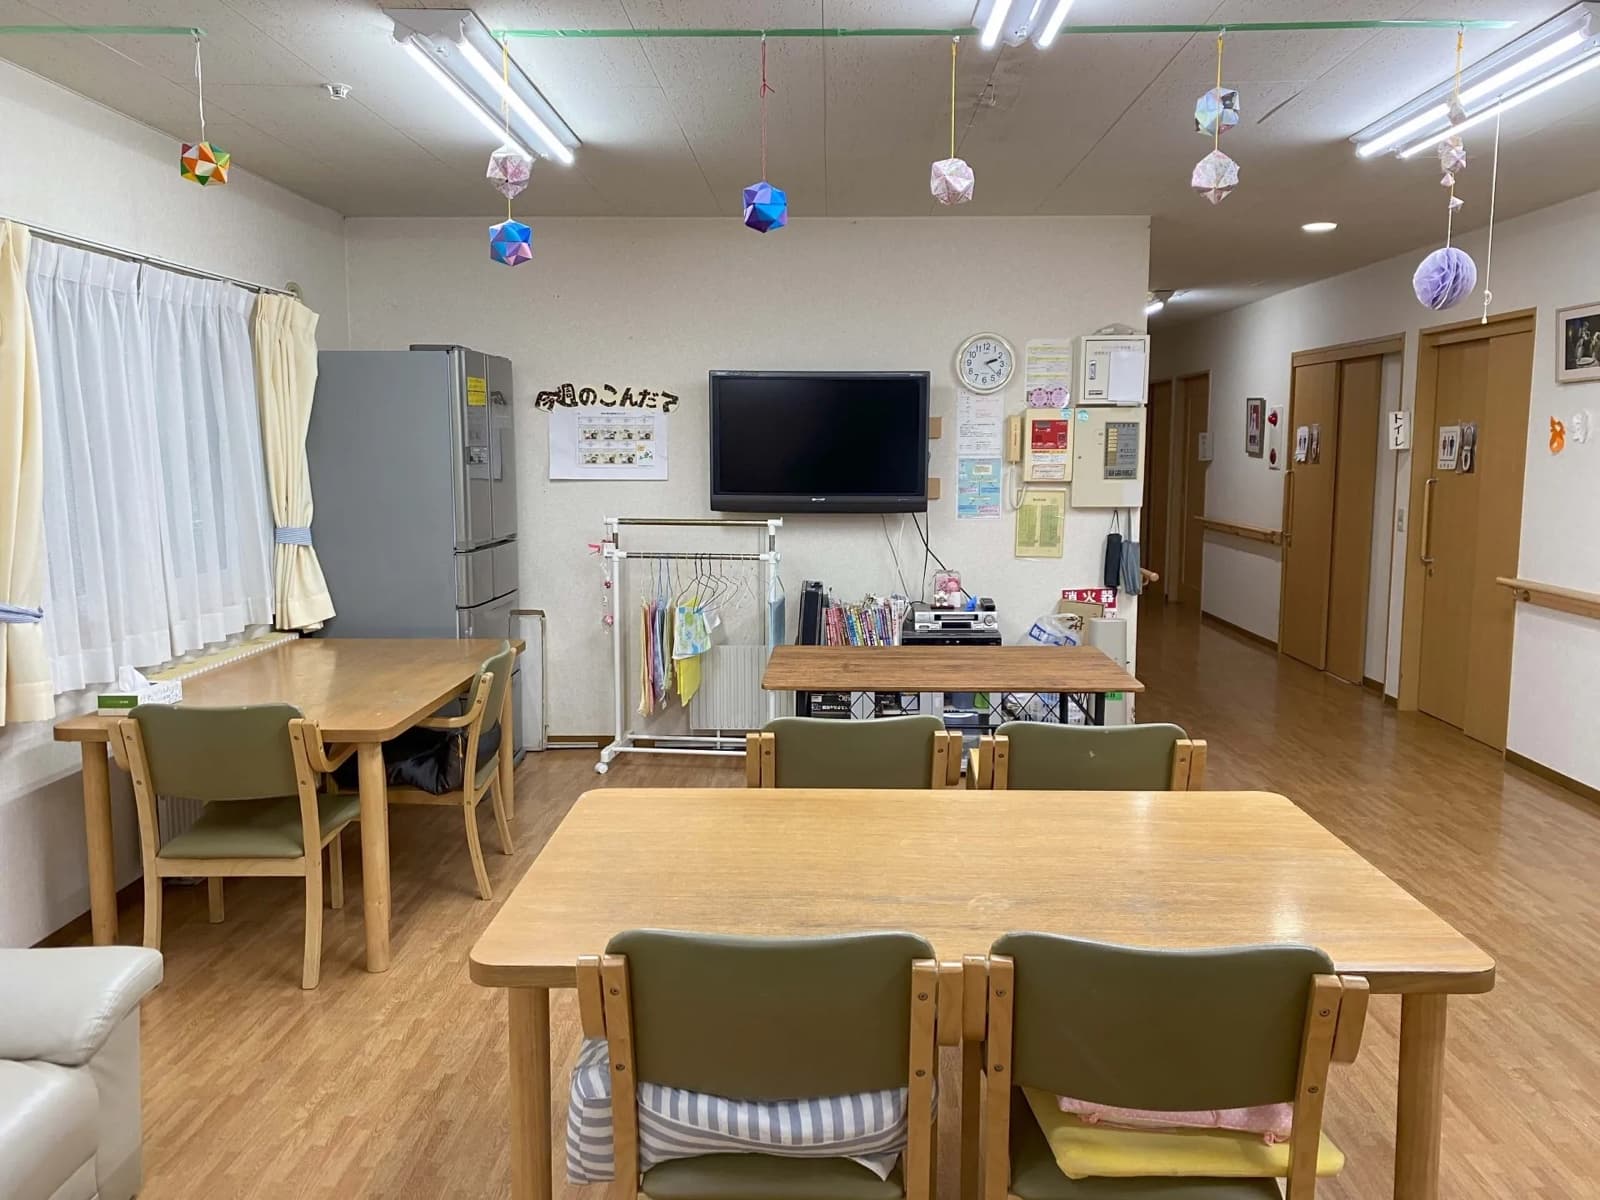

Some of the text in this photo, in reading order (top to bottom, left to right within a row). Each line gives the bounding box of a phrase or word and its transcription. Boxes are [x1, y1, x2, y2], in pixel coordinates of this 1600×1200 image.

[976, 345, 982, 353] 11
[983, 342, 991, 351] 12
[968, 350, 977, 359] 10
[998, 351, 1003, 360] 2
[966, 359, 973, 367] 9
[999, 360, 1005, 368] 3
[968, 367, 974, 376] 8
[974, 373, 980, 382] 7
[981, 376, 988, 384] 6
[990, 374, 996, 382] 5
[534, 383, 680, 413] 今週のこんだて
[1394, 413, 1405, 447] トイレ
[1063, 589, 1114, 604] 消火器
